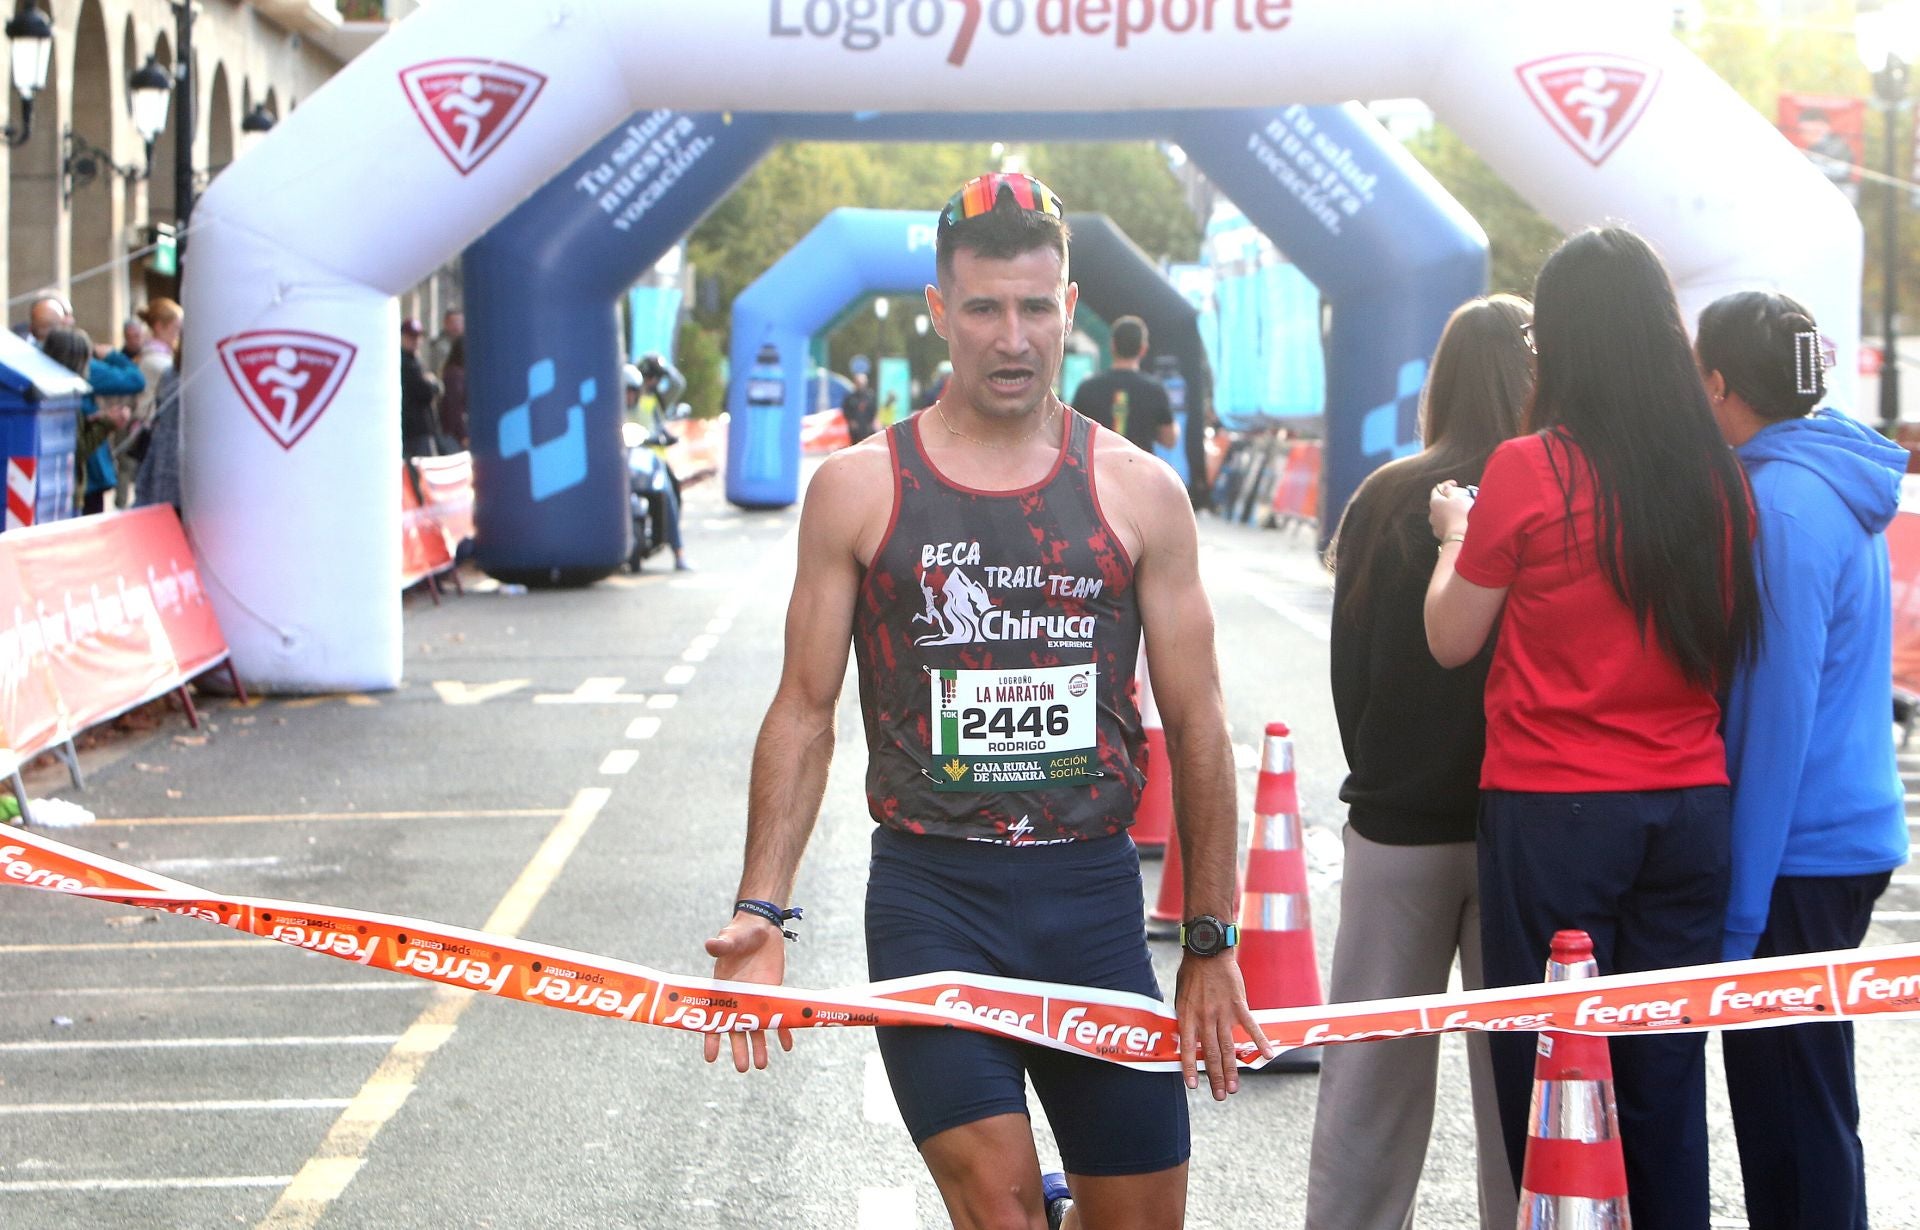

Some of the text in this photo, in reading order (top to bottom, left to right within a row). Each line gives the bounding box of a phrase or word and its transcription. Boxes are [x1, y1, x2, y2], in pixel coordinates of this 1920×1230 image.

[1036, 0, 1292, 47] deporte
[599, 116, 694, 214] nuestra
[1265, 119, 1361, 216] nuestra
[574, 162, 615, 197] Tu
[921, 541, 1104, 599] BECA TRAIL TEAM
[981, 610, 1097, 640] Chiruca
[999, 675, 1032, 685] LOGROÑO
[976, 686, 991, 703] LA
[996, 682, 1055, 702] MARATÓN
[942, 711, 957, 719] 10K
[962, 704, 1069, 740] 2446
[988, 740, 1046, 752] RODRIGO
[973, 761, 1041, 773] CAJA RURAL
[1050, 756, 1088, 768] ACCIÓN
[973, 771, 1046, 782] DE NAVARRA
[1050, 767, 1086, 779] SOCIAL
